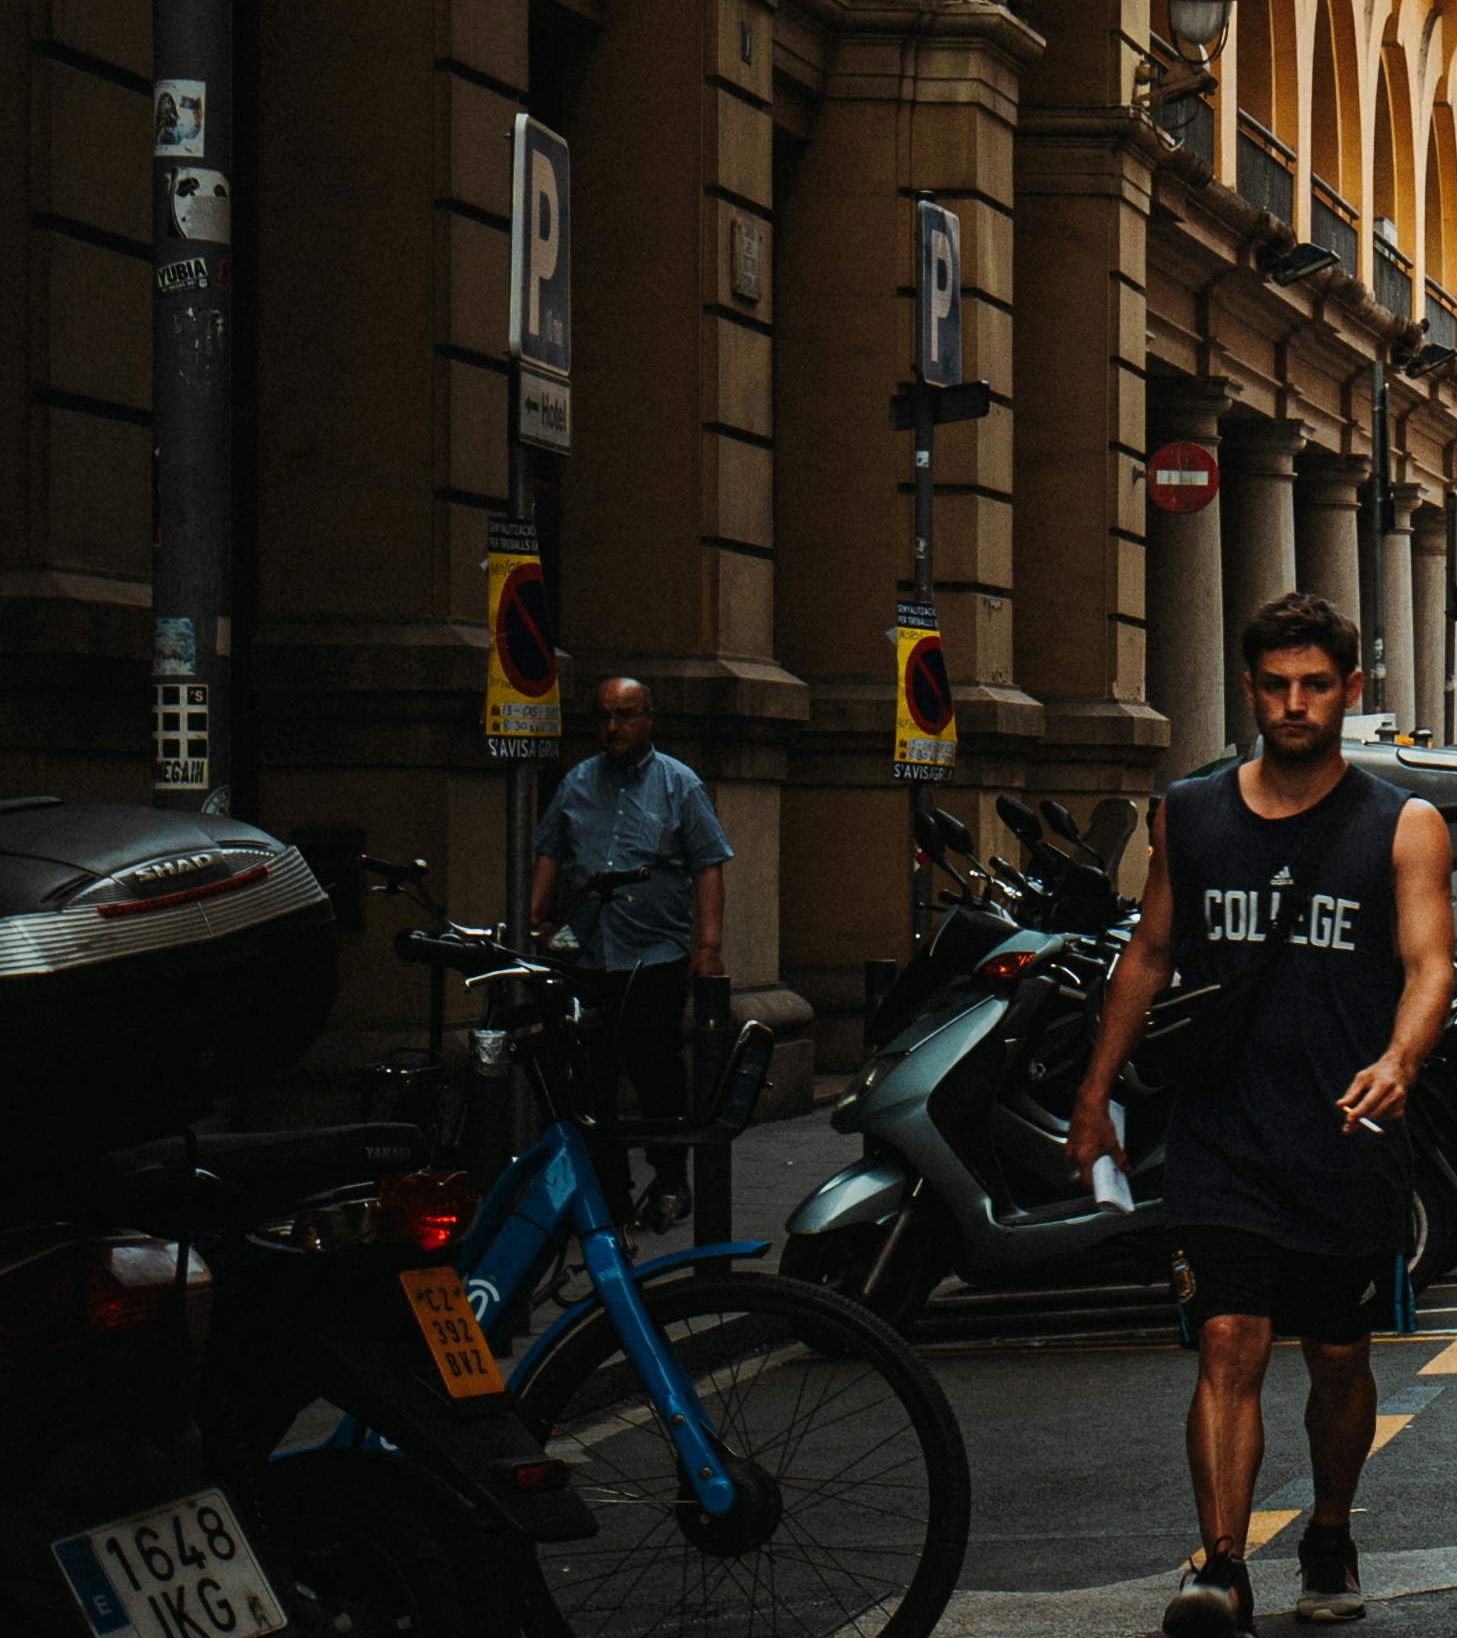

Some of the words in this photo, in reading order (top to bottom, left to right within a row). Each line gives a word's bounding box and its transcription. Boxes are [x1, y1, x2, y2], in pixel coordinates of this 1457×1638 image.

[528, 147, 560, 337] P
[931, 228, 953, 363] P
[541, 390, 568, 434] Hotel
[134, 853, 215, 883] SHAD
[424, 1285, 454, 1312] C2
[431, 1317, 475, 1345] 392
[444, 1348, 489, 1378] BVZ
[105, 1505, 237, 1592] 1648
[92, 1593, 113, 1617] E
